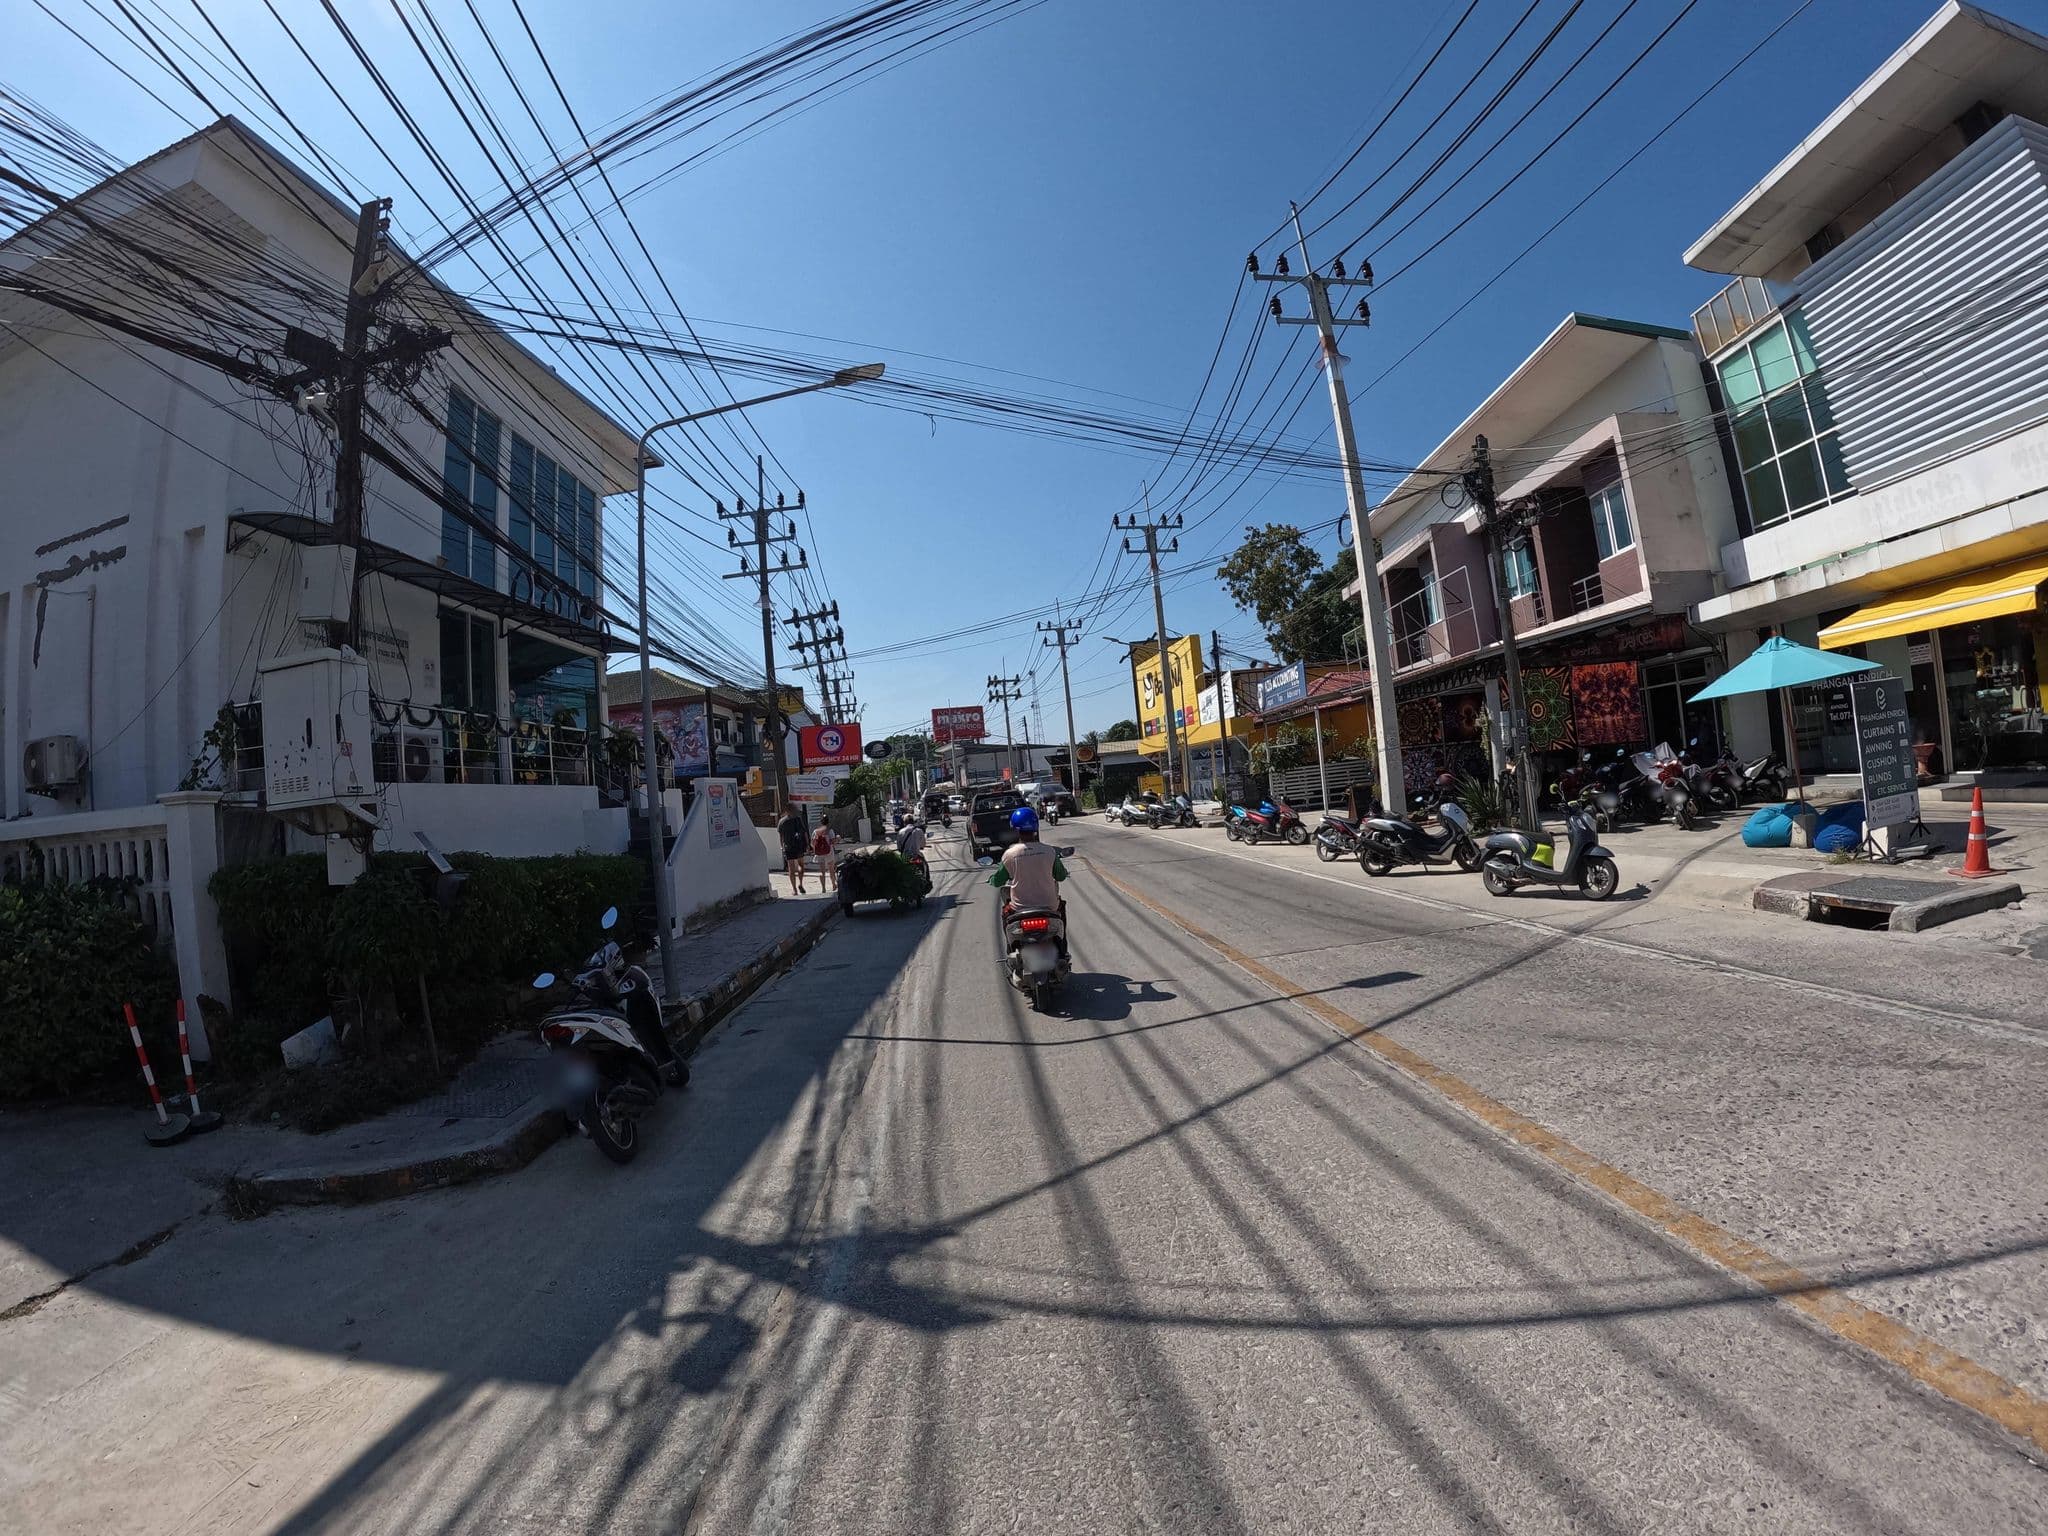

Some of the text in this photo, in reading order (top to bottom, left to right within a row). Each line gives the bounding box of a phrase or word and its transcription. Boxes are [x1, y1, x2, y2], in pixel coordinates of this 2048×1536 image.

[1862, 724, 1896, 740] CURTAINS
[1864, 740, 1893, 755] AWNING
[804, 756, 840, 764] EMERGENCY
[1866, 754, 1897, 770] CUSHION
[1868, 770, 1893, 785] BLINDS
[1886, 781, 1908, 794] SERVICE
